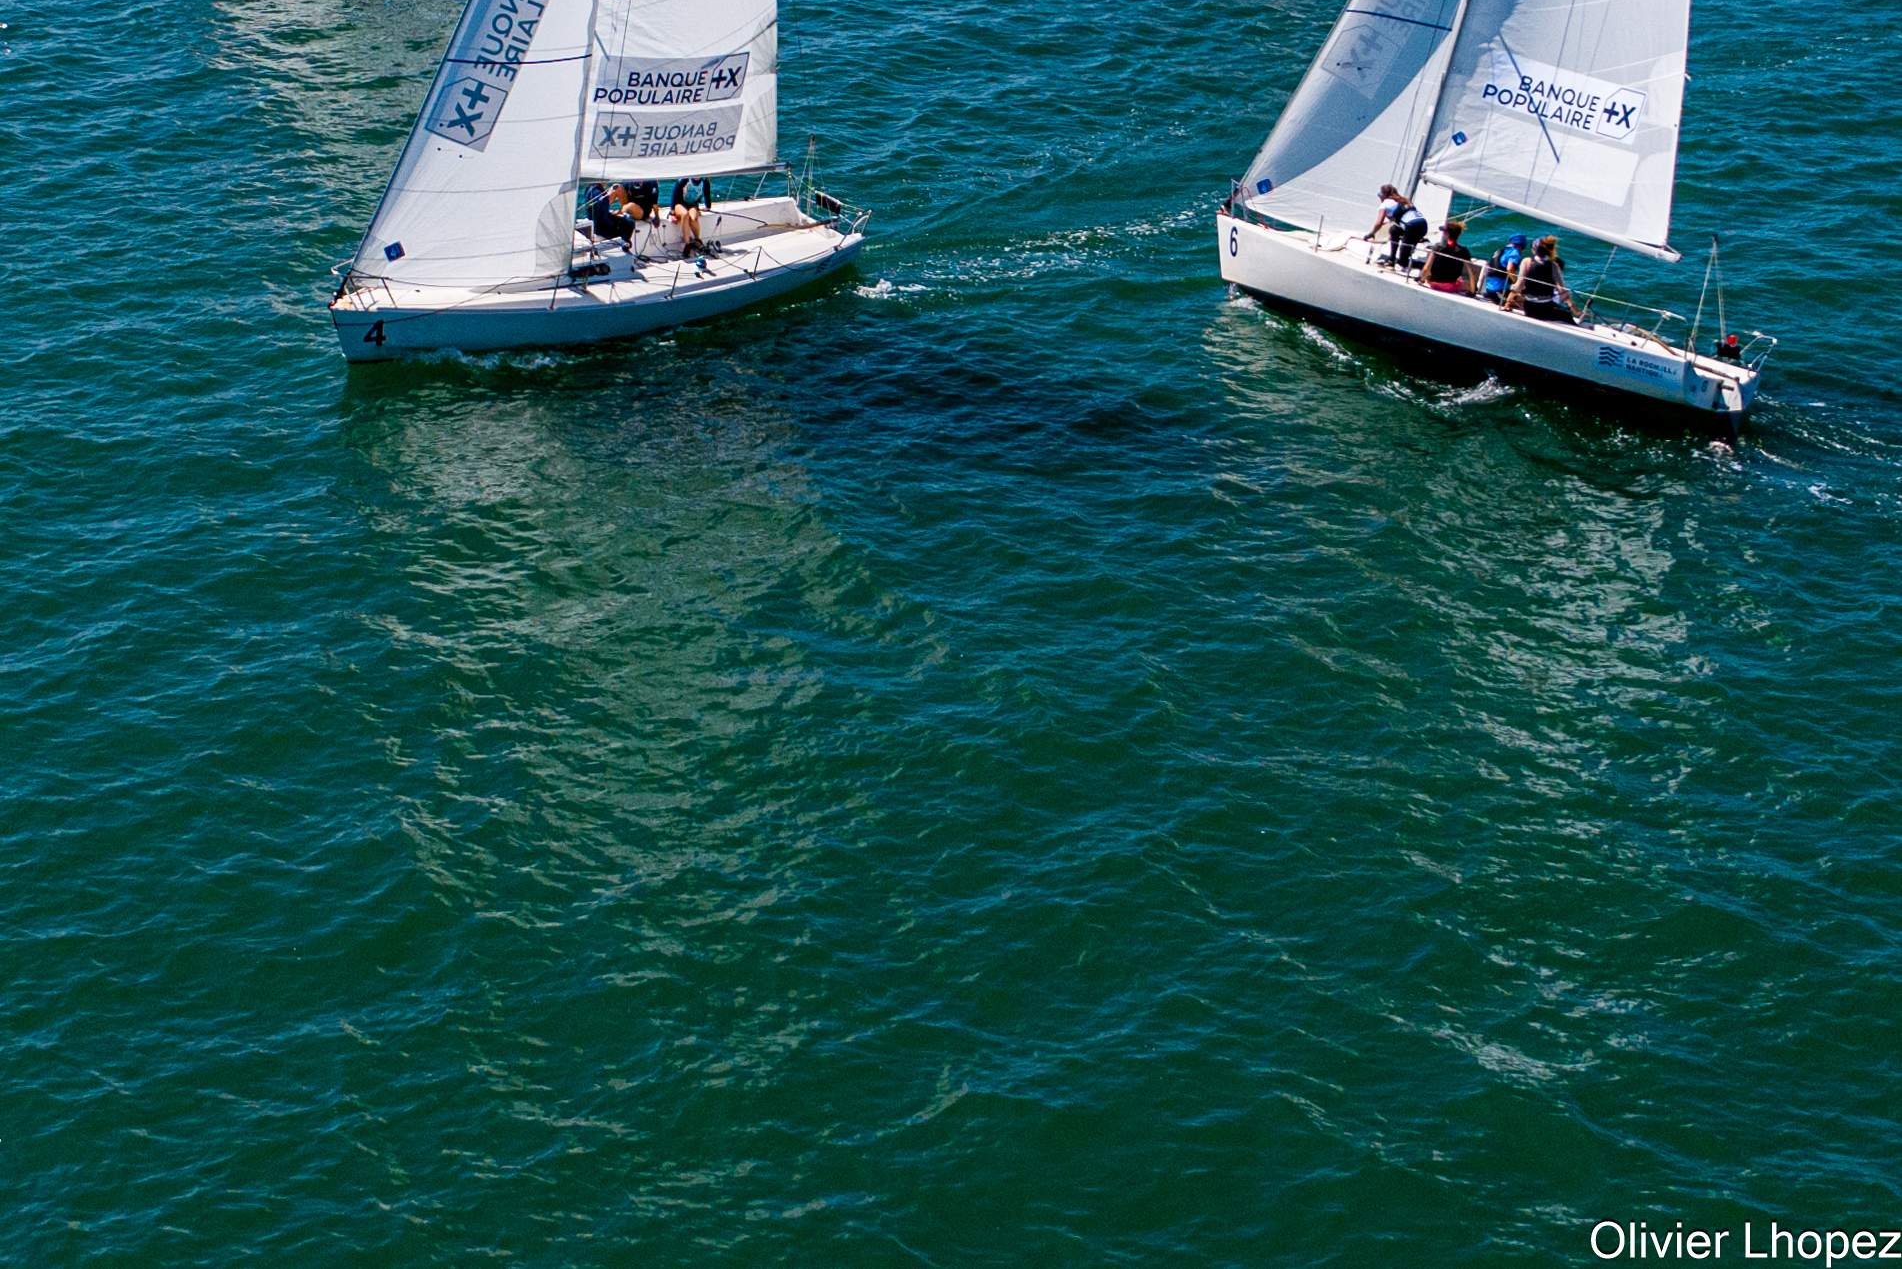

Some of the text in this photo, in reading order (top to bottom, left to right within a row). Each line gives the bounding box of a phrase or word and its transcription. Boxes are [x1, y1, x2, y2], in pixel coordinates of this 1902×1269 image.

[627, 70, 709, 88] BANQUE
[1518, 75, 1601, 112] BANQUE
[594, 87, 704, 105] POPULAIRE
[1482, 84, 1595, 130] POPULAIRE
[1230, 226, 1238, 257] 6
[363, 319, 387, 346] 4
